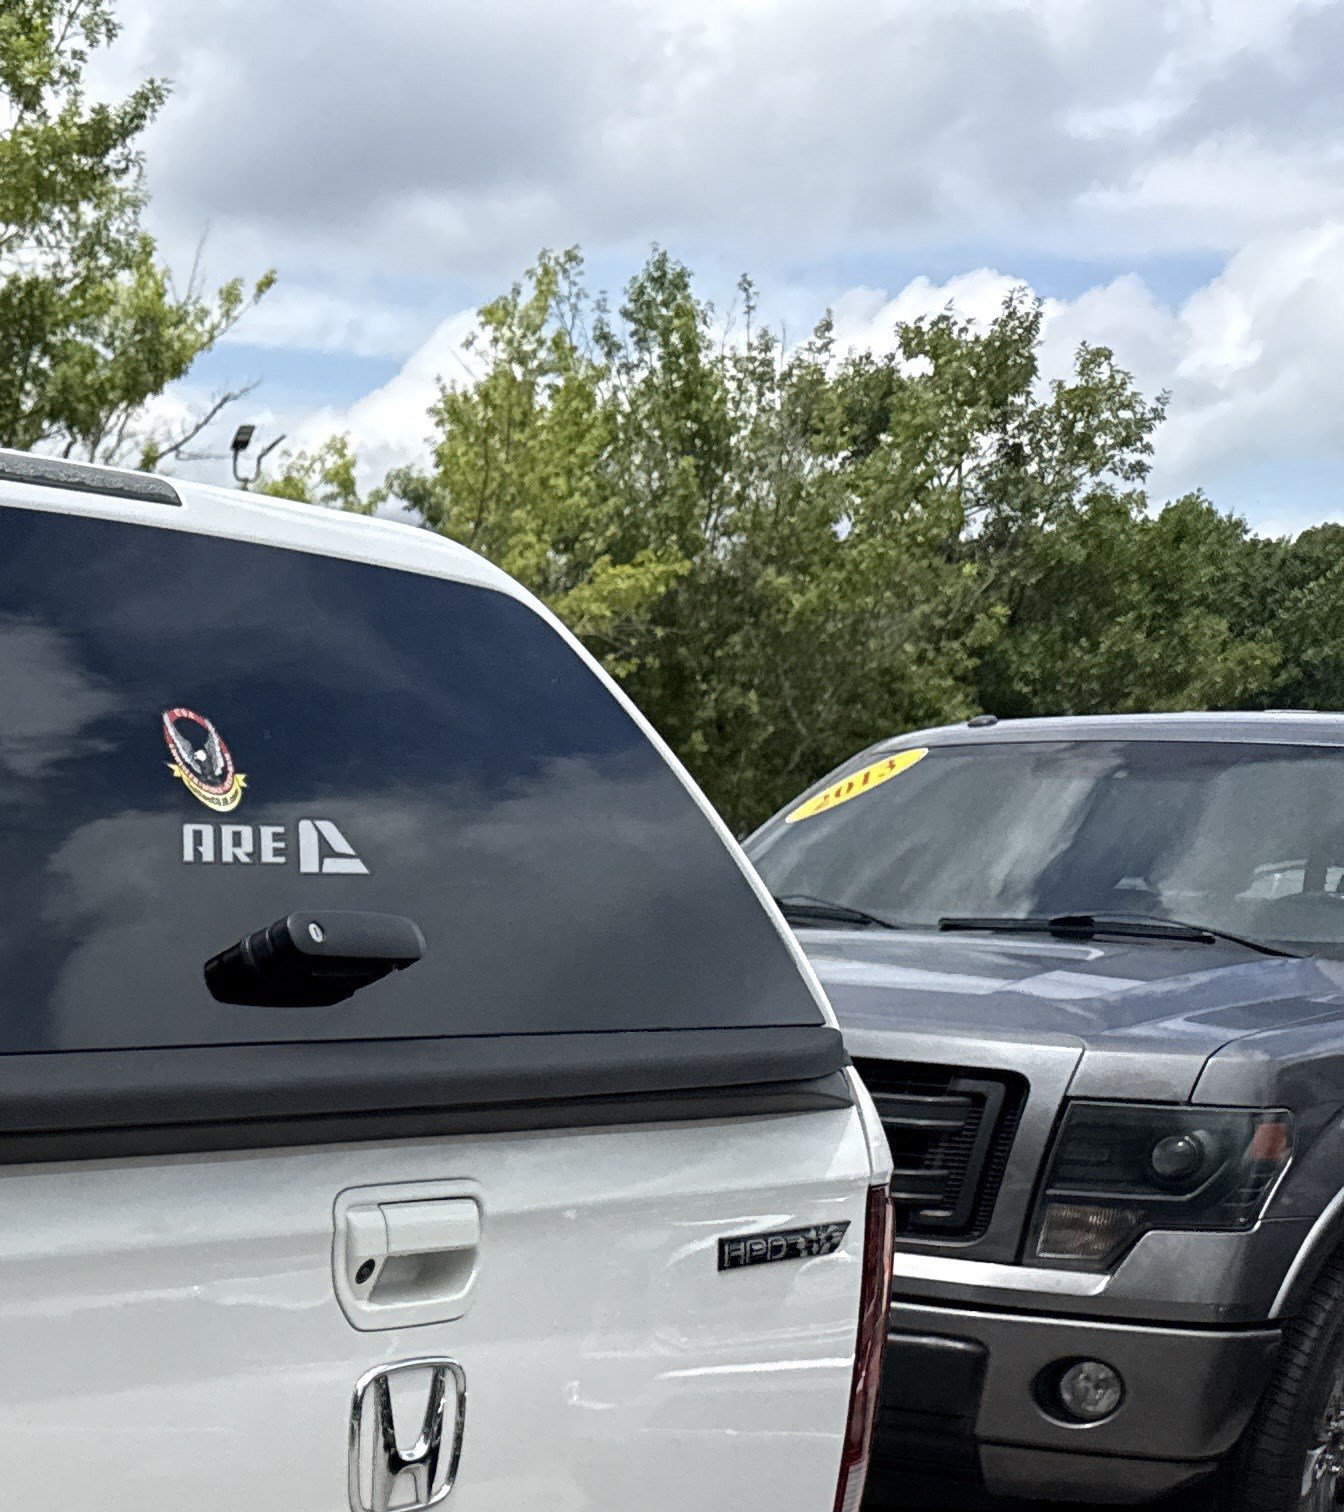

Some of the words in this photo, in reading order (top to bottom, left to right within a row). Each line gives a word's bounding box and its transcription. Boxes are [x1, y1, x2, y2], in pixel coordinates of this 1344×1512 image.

[814, 759, 897, 812] 2013
[181, 822, 288, 864] ARE
[723, 1235, 788, 1268] HPD
